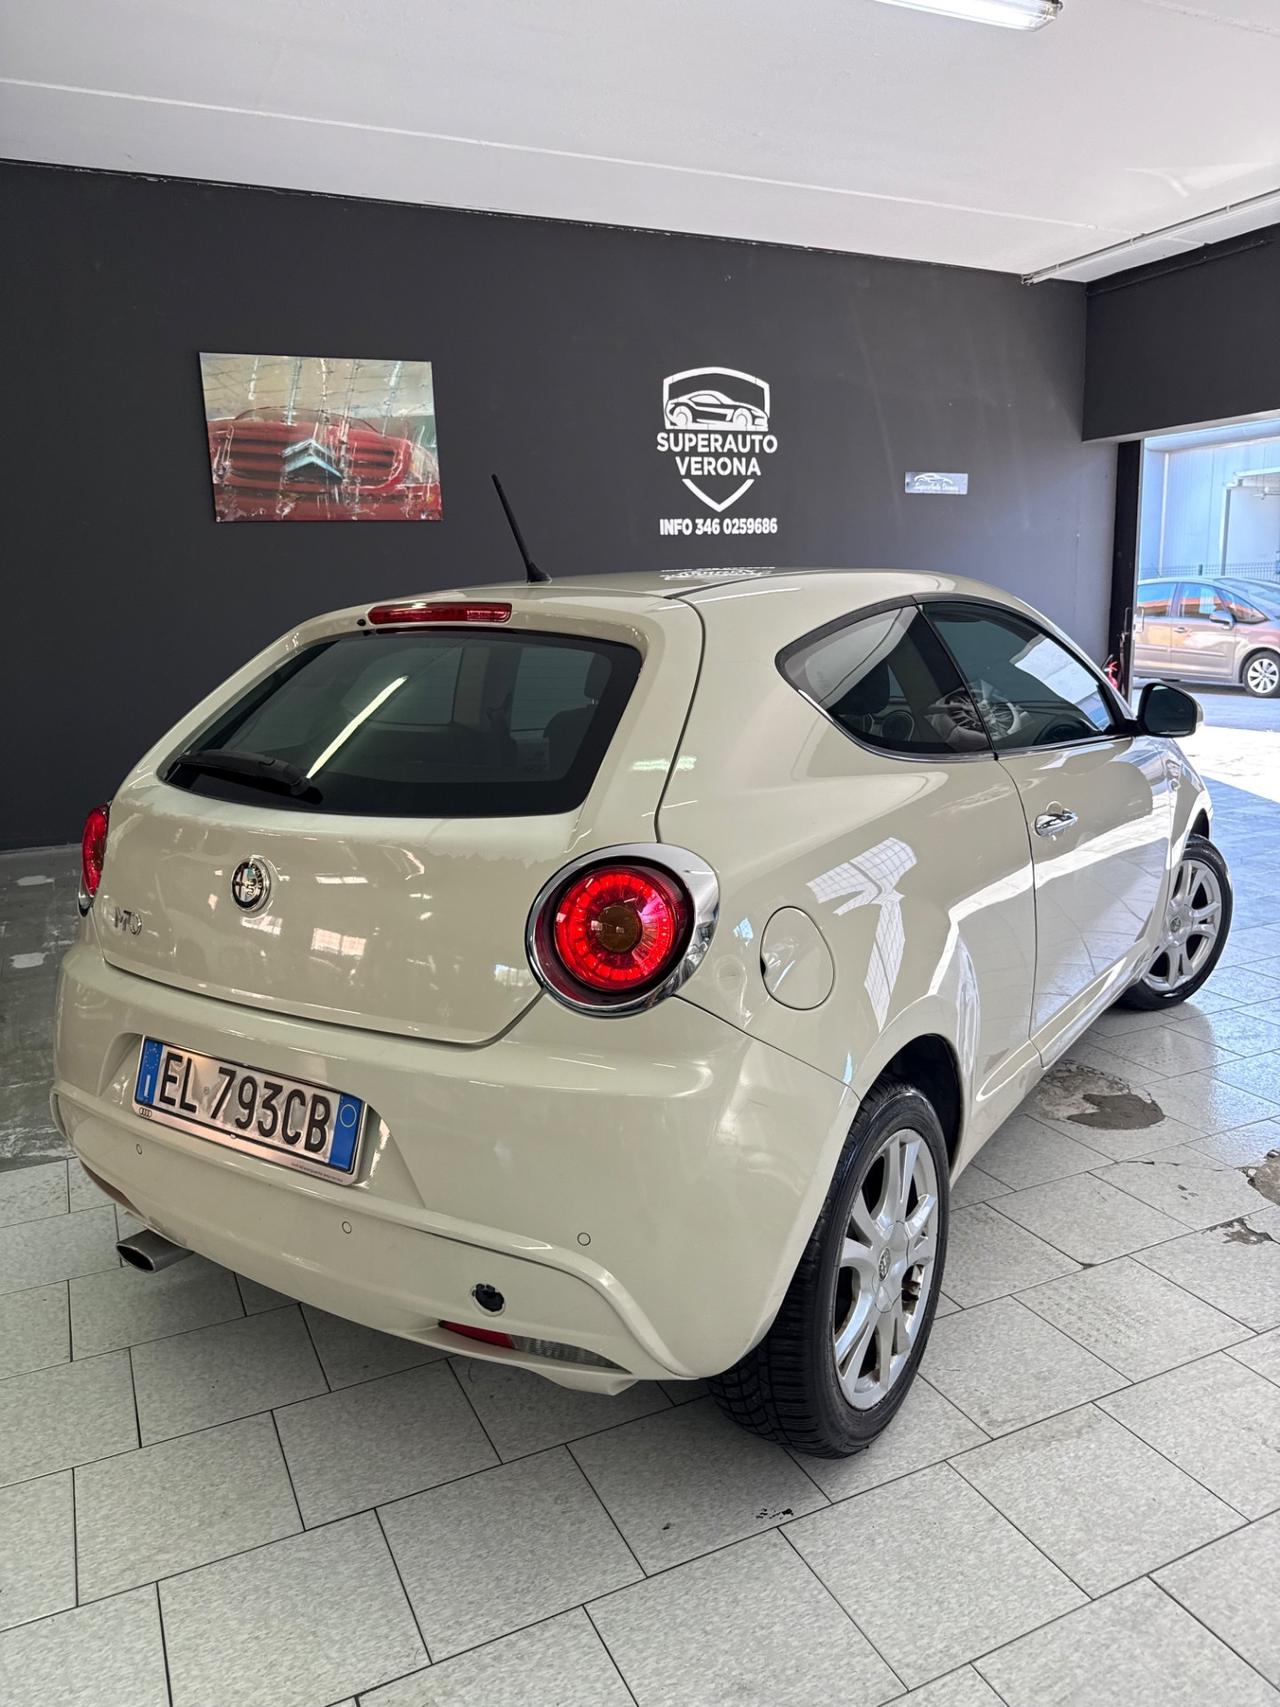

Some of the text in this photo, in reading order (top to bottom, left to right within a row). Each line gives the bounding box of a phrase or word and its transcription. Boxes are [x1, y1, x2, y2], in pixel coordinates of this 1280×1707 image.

[656, 432, 778, 453] SUPERAUTO
[675, 456, 761, 476] VERONA
[659, 518, 778, 535] INFO 346 0259686
[159, 1051, 331, 1153] EL 793CB
